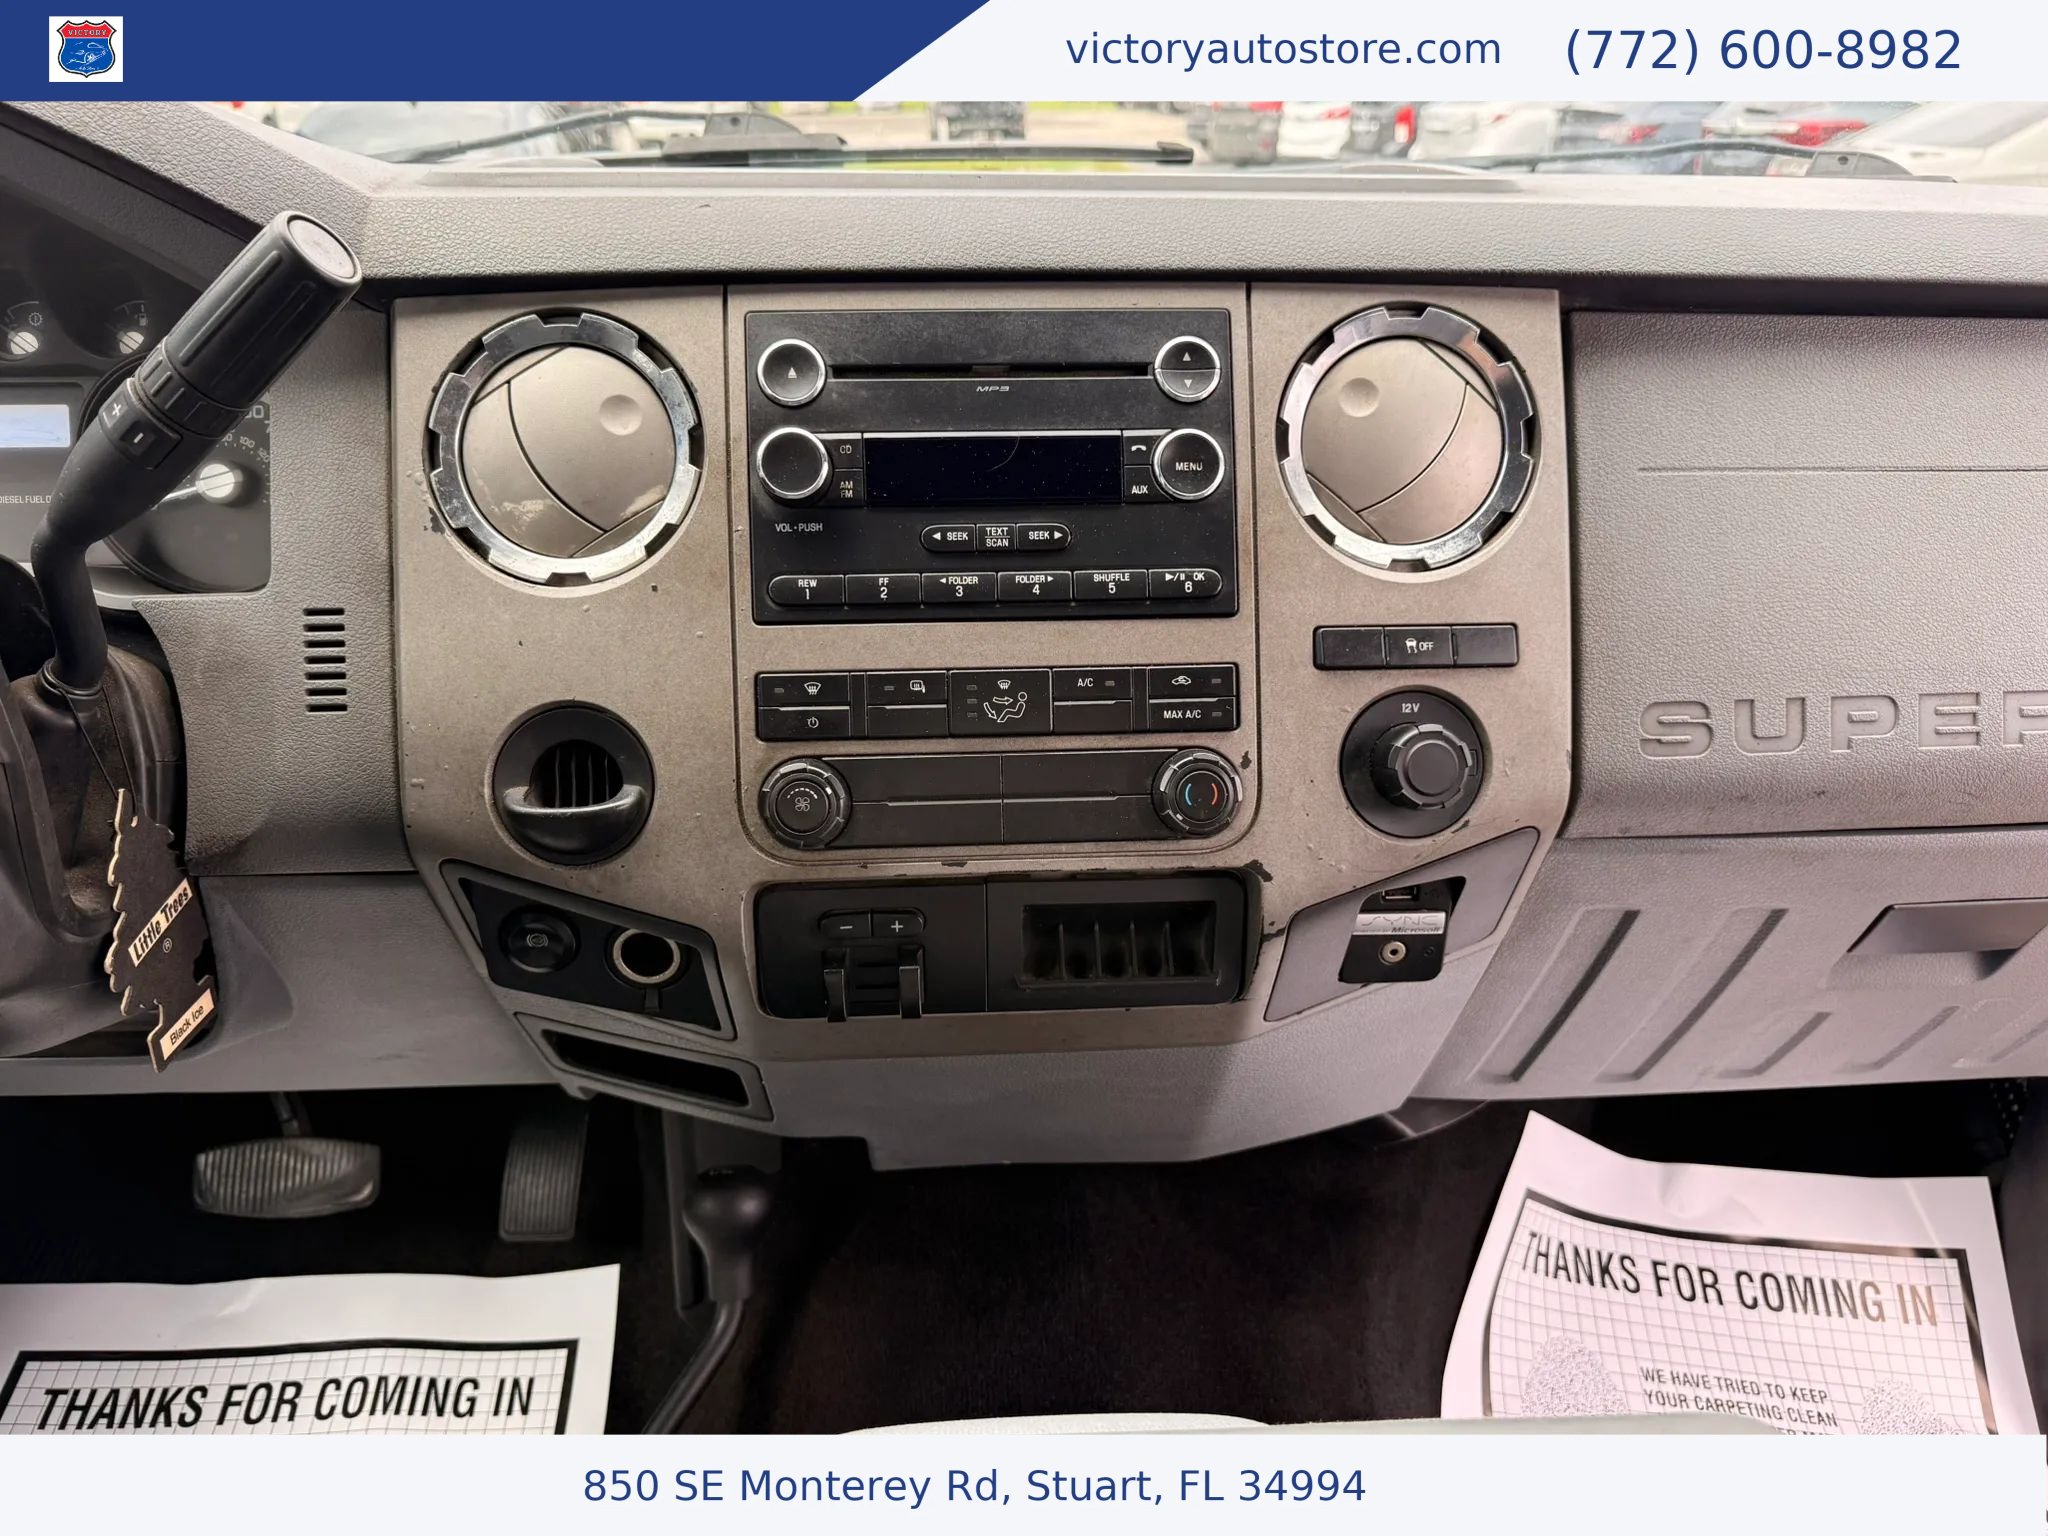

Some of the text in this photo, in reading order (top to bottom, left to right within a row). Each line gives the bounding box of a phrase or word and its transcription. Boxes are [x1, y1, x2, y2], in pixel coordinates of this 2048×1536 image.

[839, 445, 852, 454] CD
[1175, 462, 1203, 471] MENU
[840, 481, 854, 489] AM
[1131, 485, 1149, 494] AUX
[840, 490, 854, 498] FM
[25, 495, 45, 504] FUEL
[946, 531, 968, 541] SEEK
[985, 527, 1008, 536] TEXT
[1028, 531, 1050, 540] SEEK
[985, 538, 1009, 547] SCAN
[878, 577, 889, 586] FF
[948, 576, 979, 585] FOLDER
[1015, 575, 1046, 584] FOLDER
[1093, 573, 1130, 582] SHUFFLE
[1193, 573, 1205, 581] OK
[798, 579, 818, 588] REW
[1108, 582, 1116, 594] 5
[1184, 581, 1193, 593] 6
[880, 587, 888, 598] 2
[955, 585, 964, 597] 3
[1032, 584, 1040, 595] 4
[1418, 641, 1434, 651] OFF
[1077, 678, 1094, 687] A/C
[1401, 703, 1420, 713] 12V
[1163, 709, 1202, 719] MAX A/C
[132, 886, 188, 957] Little Trees
[169, 1005, 204, 1046] Black Ice
[1522, 1231, 1939, 1327] THANKS FOR COMING IN
[1641, 1367, 1828, 1405] WE HAVE TRIED TO KEEP
[37, 1376, 534, 1430] THANKS FOR COMING IN
[1644, 1389, 1839, 1428] YOUR CARPETING CLEAN
